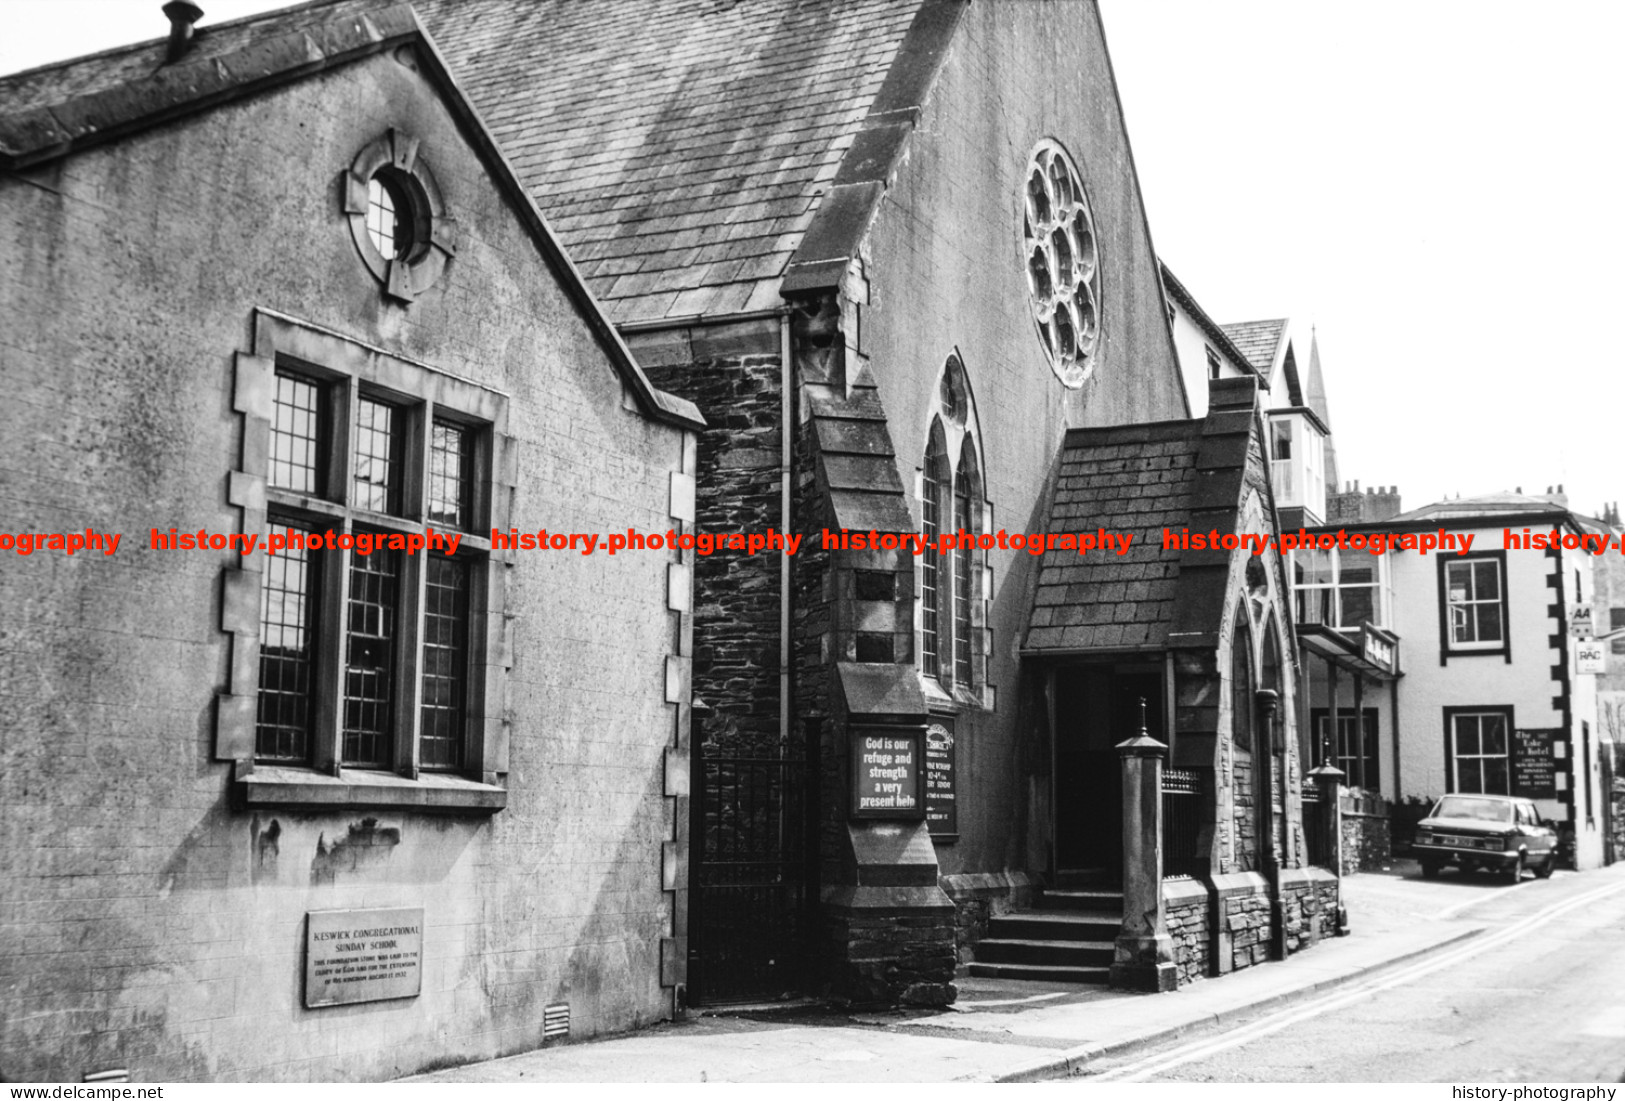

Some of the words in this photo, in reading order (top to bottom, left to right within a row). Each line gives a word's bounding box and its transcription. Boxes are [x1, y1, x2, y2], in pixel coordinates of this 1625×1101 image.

[1579, 650, 1601, 660] RAC
[865, 737, 883, 749] God
[884, 738, 893, 749] is
[894, 740, 910, 749] our
[863, 751, 893, 766] refuge
[894, 752, 912, 764] and
[869, 767, 908, 781] strength
[874, 782, 881, 792] a
[882, 782, 903, 796] very
[860, 796, 895, 808] present
[313, 931, 350, 942] KESWICK
[353, 926, 420, 939] CONGREGATIONAL
[335, 942, 366, 953] SUNDAY
[370, 940, 398, 950] SCHOOL
